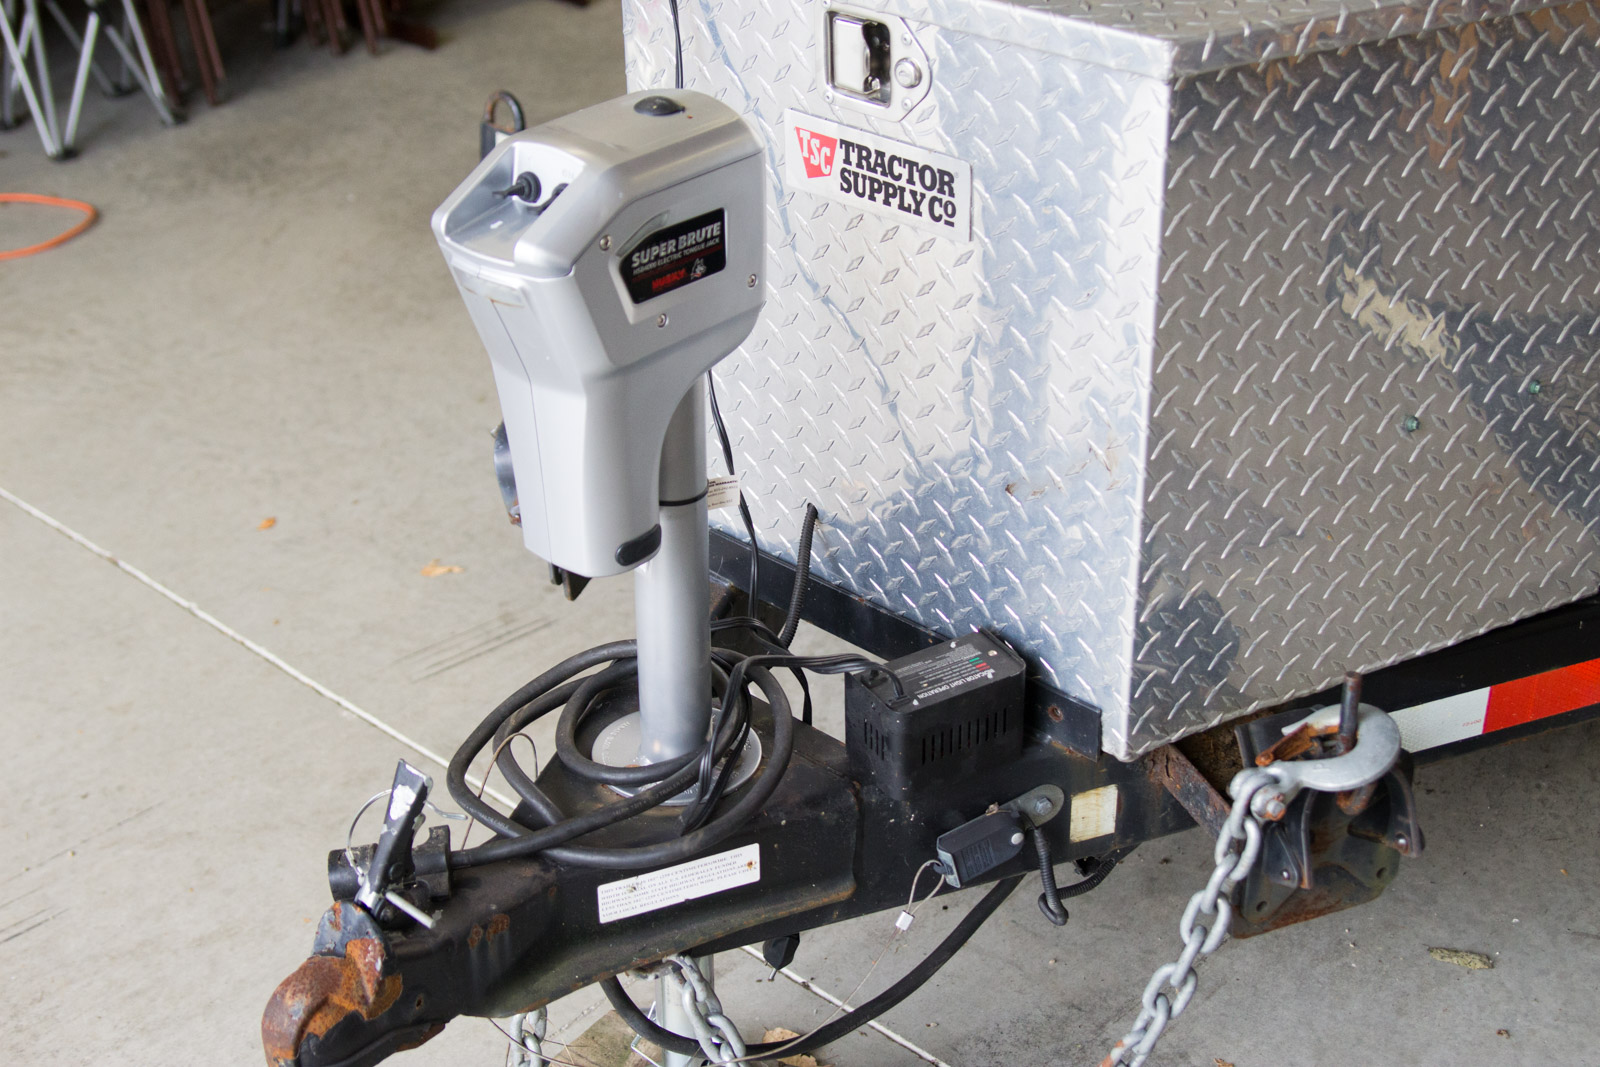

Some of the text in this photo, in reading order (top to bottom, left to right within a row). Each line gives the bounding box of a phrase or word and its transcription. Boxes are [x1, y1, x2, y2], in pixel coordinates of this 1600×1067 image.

[799, 130, 831, 175] TSC
[839, 138, 955, 198] TRACTOR
[840, 167, 926, 217] SUPPLY
[631, 221, 721, 268] SUPER BRUTE
[706, 237, 720, 248] JACK
